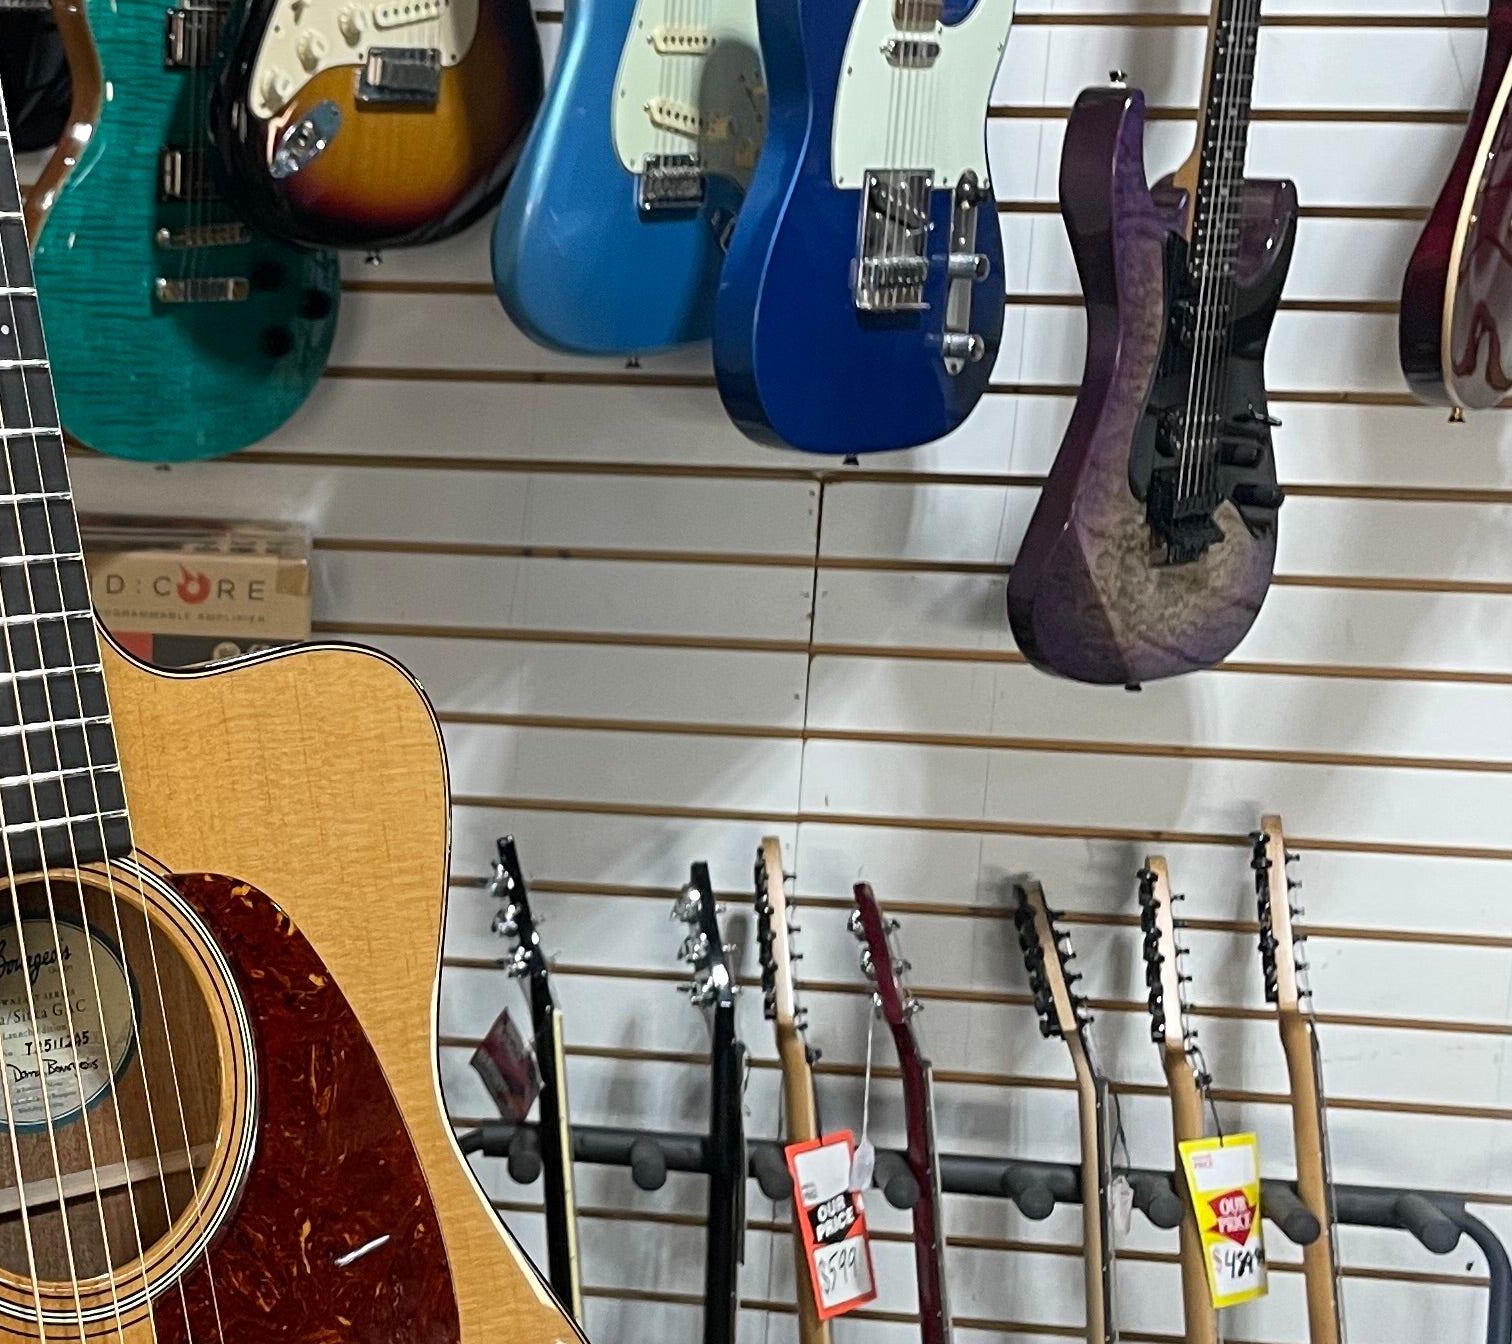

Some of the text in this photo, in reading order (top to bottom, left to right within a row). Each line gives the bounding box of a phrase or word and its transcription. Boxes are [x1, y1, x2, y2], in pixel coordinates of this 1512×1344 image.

[816, 1194, 846, 1224] OUR
[1218, 1195, 1249, 1219] OUR
[815, 1205, 855, 1244] PRICE
[818, 1246, 858, 1296] $599
